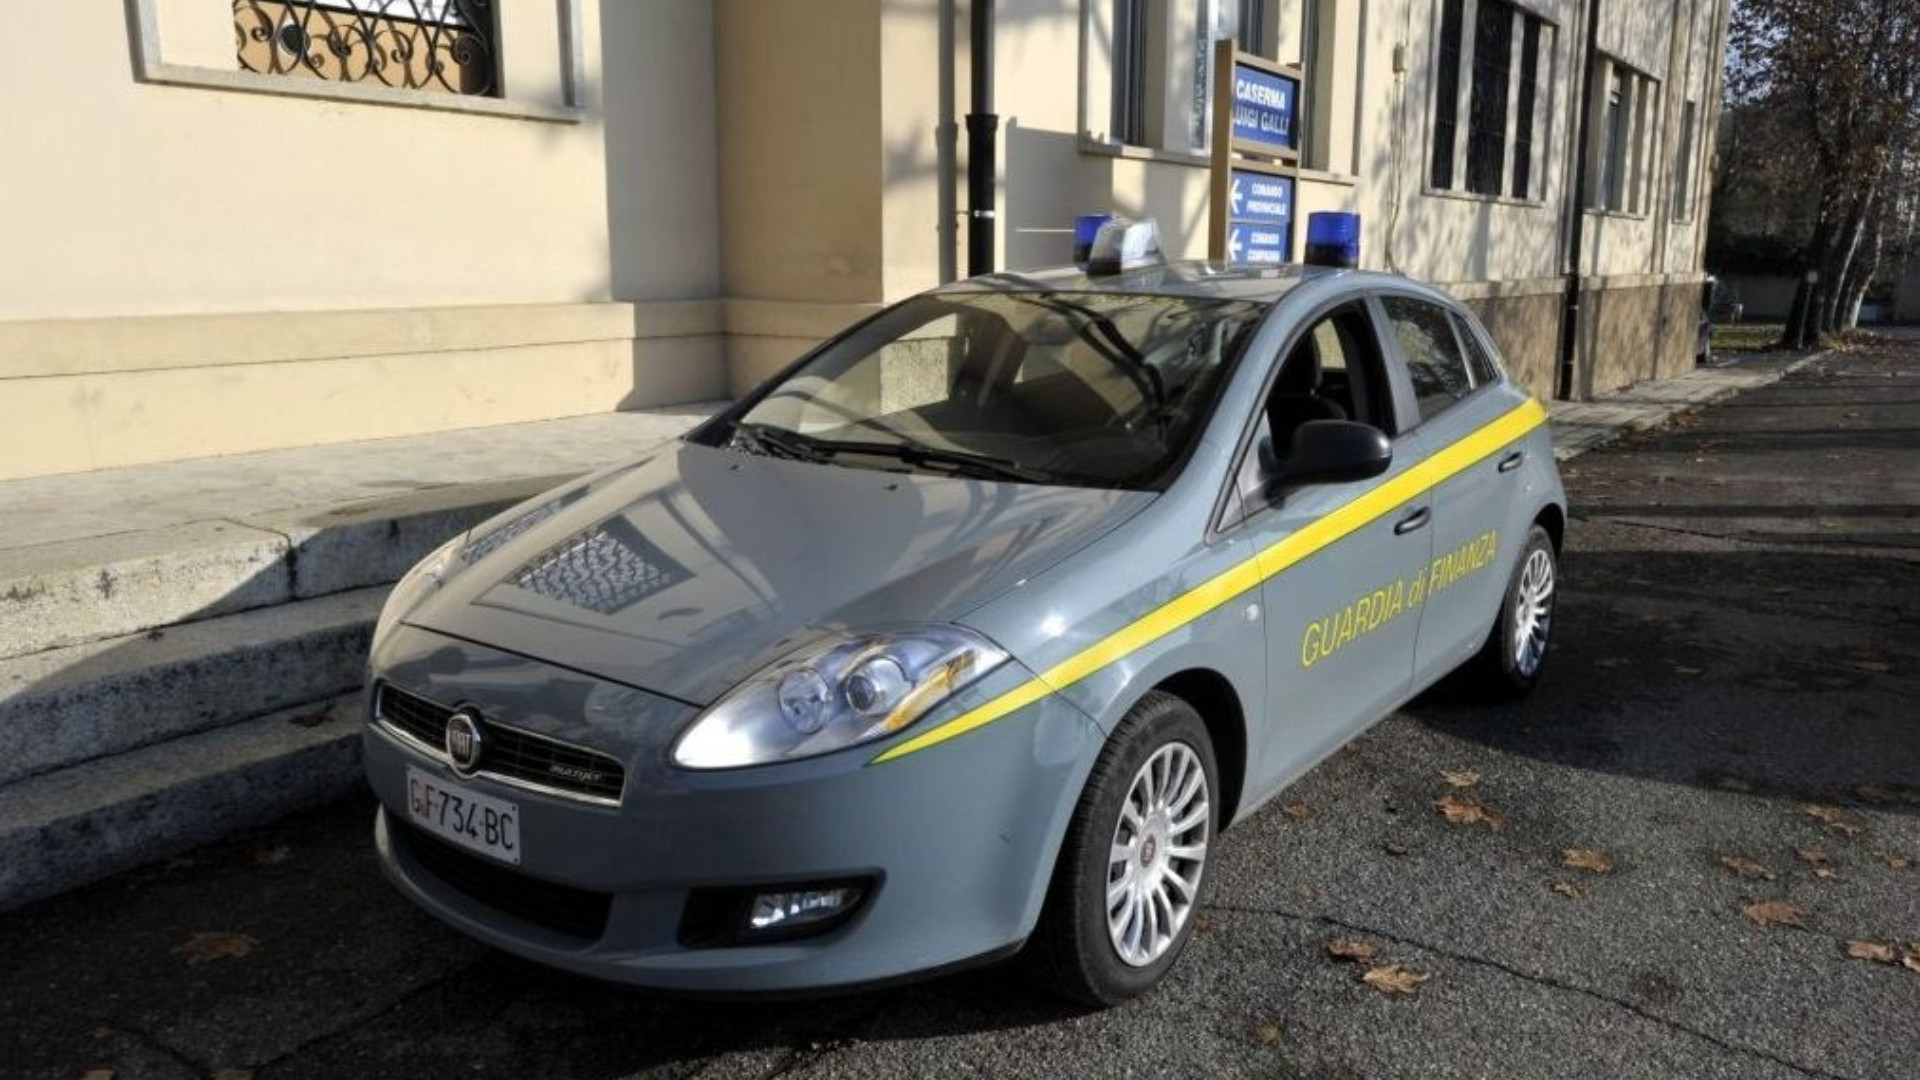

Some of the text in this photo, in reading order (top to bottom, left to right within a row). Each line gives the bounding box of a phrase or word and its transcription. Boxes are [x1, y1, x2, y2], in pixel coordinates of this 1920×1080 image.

[1236, 79, 1285, 110] CASERMA
[1302, 528, 1497, 667] GUARDIA di FINANZA
